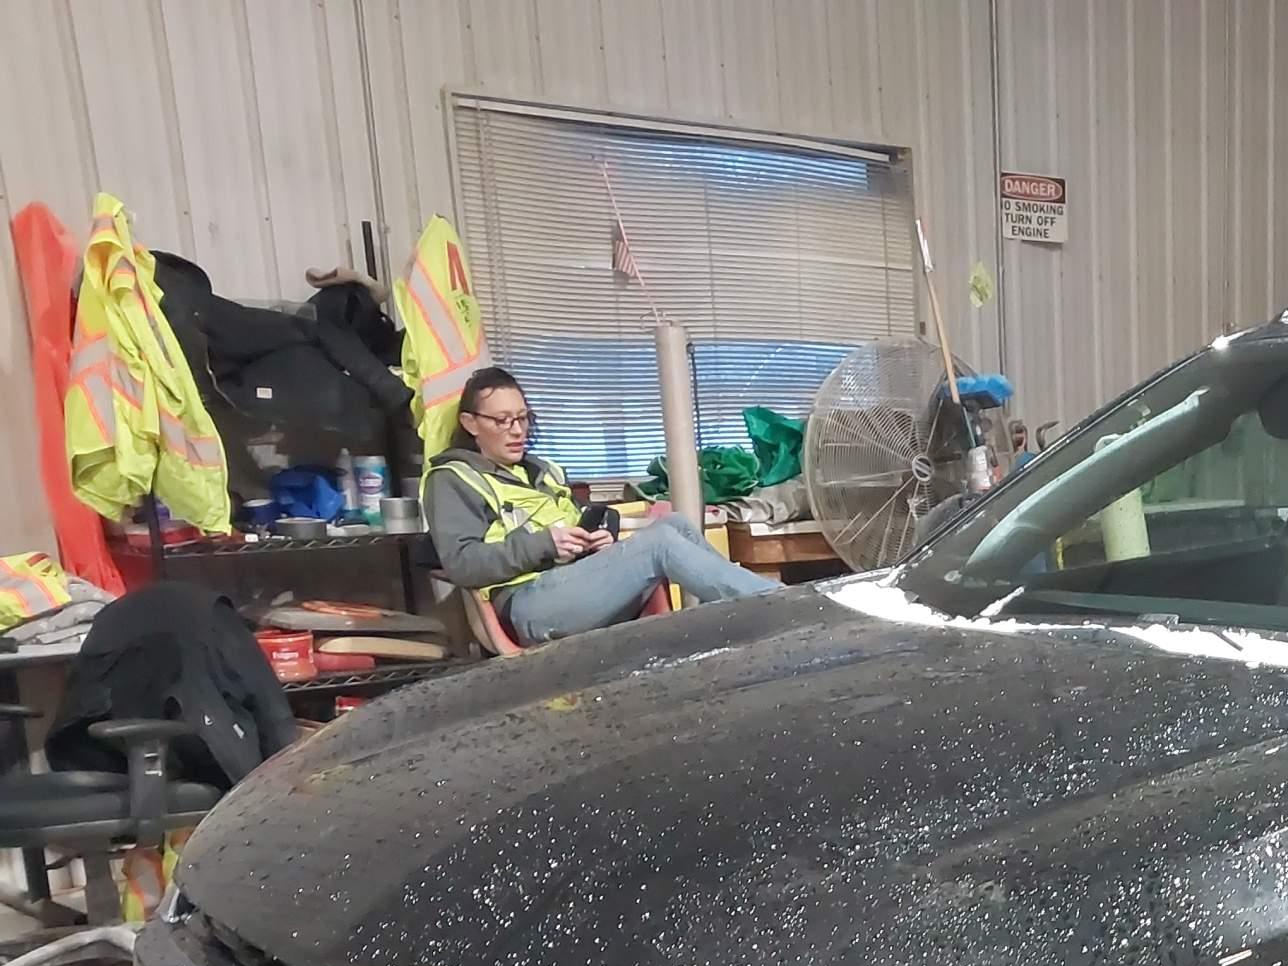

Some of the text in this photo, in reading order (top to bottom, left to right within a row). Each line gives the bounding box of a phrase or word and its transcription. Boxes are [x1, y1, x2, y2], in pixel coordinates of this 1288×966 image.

[1004, 179, 1057, 197] DANGER
[1015, 201, 1064, 215] SMOKING
[1004, 213, 1056, 227] TURN OFF
[1011, 225, 1050, 239] ENGINE
